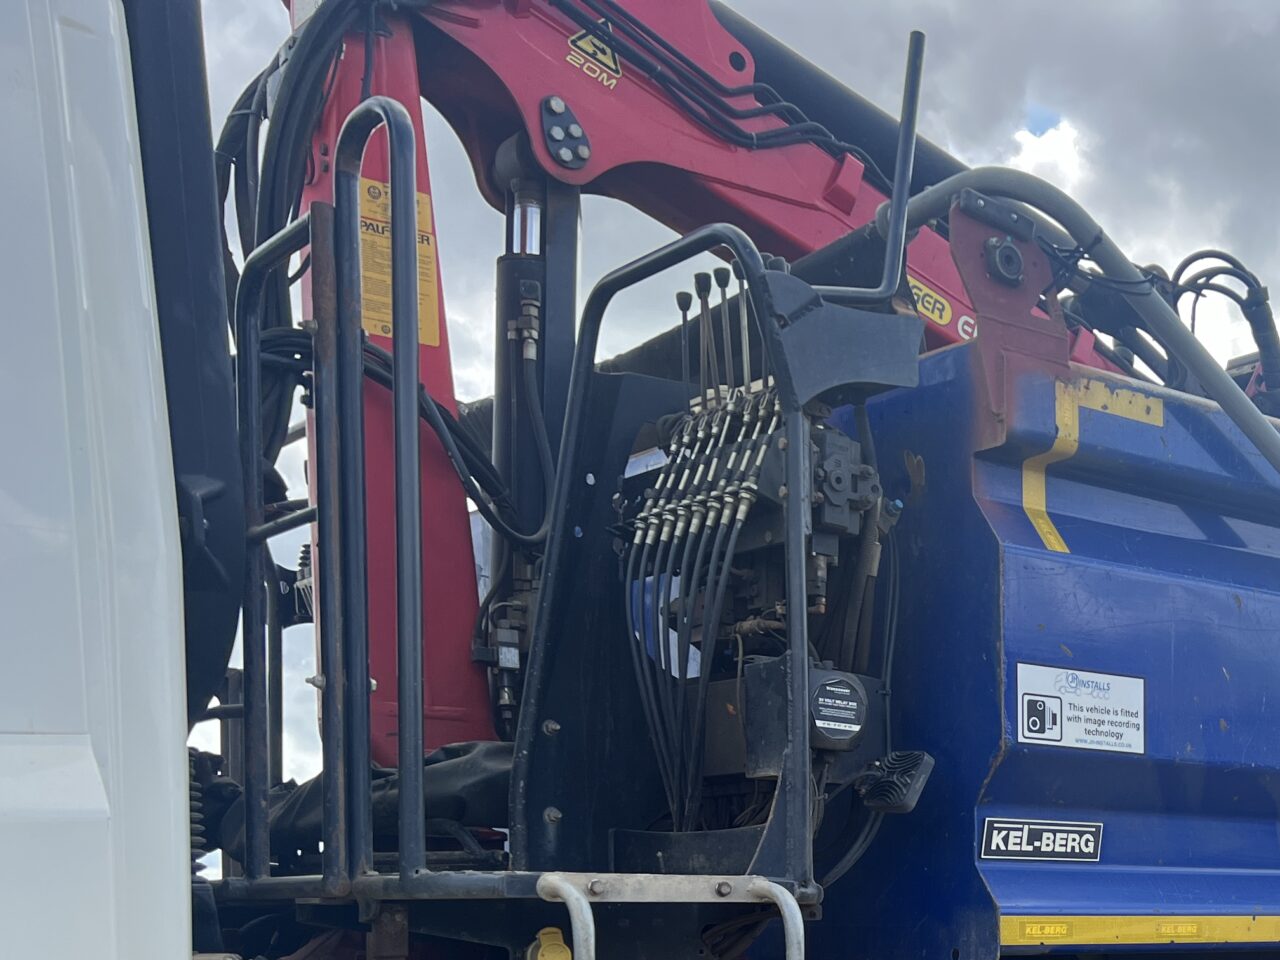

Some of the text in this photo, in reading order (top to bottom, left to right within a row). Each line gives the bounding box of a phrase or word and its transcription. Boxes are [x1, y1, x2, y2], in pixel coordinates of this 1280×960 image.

[566, 50, 617, 90] 20M
[1068, 702, 1139, 719] This vehicle is fitted
[1066, 714, 1140, 731] with image recording
[1084, 727, 1124, 740] technology
[990, 824, 1096, 854] KEL-BERG
[1025, 924, 1068, 935] KEL-BERG
[1160, 924, 1198, 935] KEL-BERG
